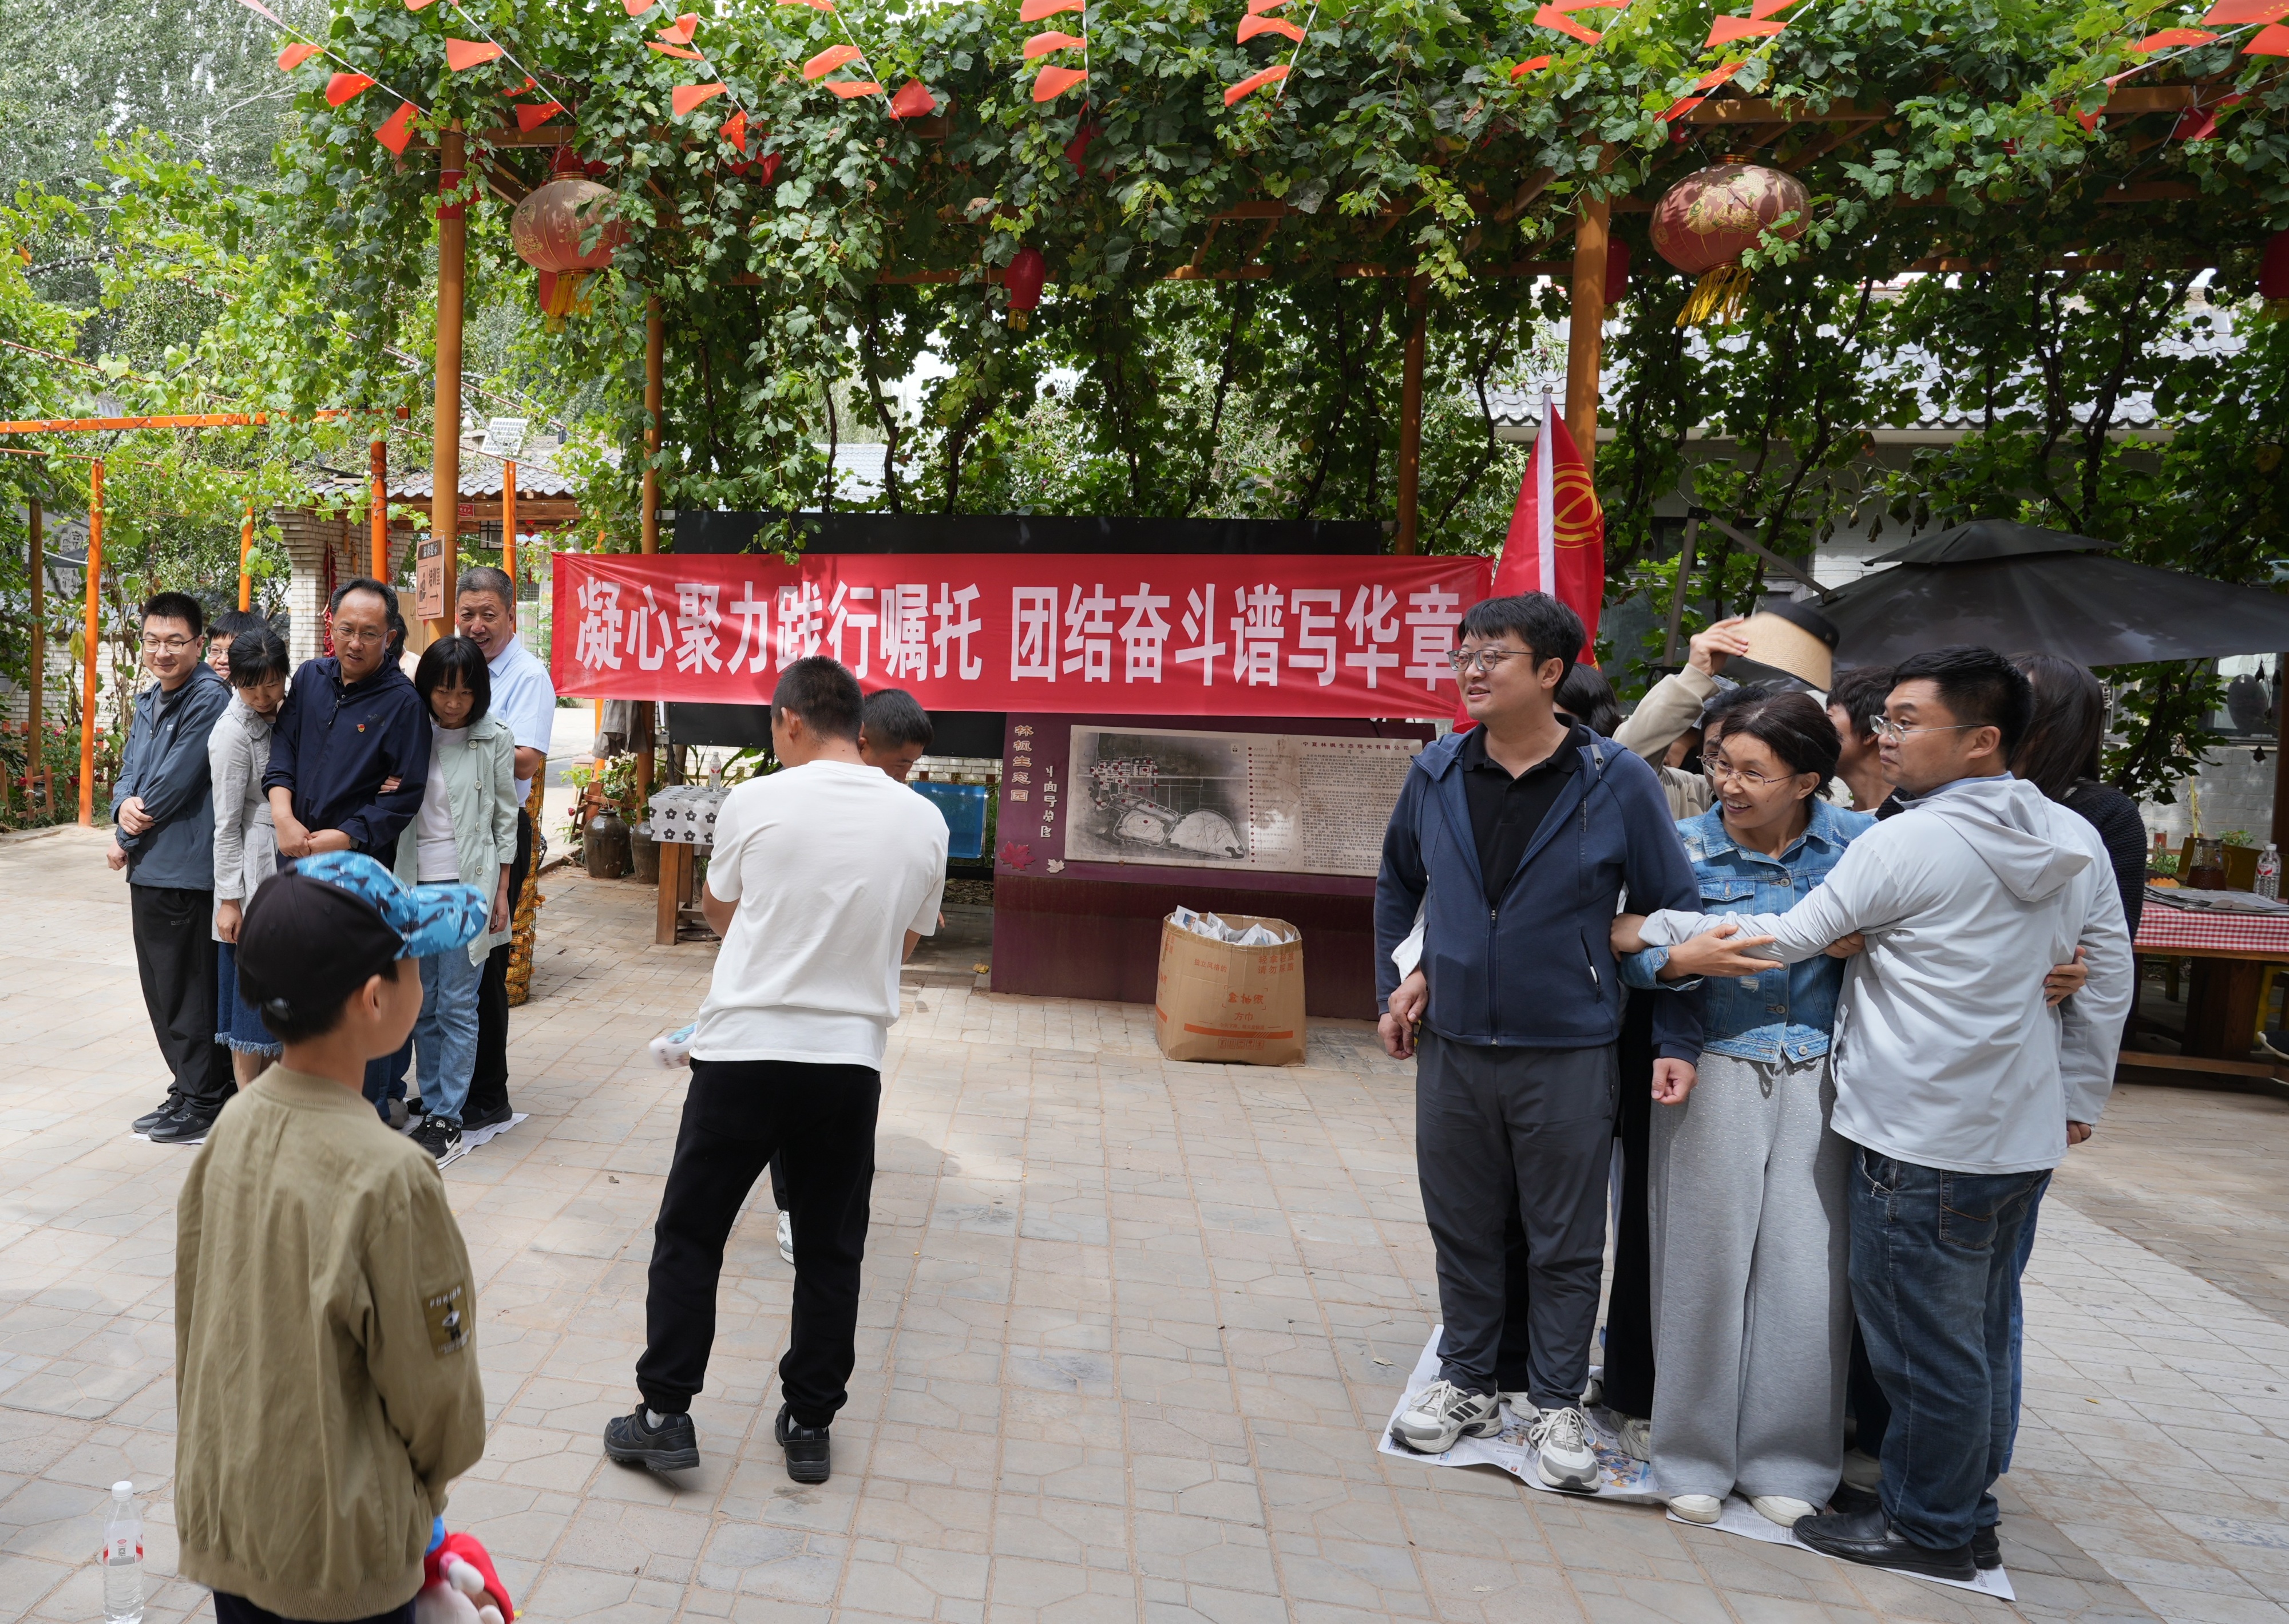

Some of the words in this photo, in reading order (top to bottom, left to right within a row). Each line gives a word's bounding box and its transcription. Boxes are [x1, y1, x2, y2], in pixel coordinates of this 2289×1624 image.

[575, 577, 983, 682] 凝心聚力践行嘱托
[1011, 583, 1463, 691] 团结奋斗谱写华章
[1302, 742, 1409, 751] 宁夏林枫生态观光有限公司
[1011, 725, 1034, 802] 林枫生态园
[1259, 951, 1295, 964] 轻拿轻放
[1194, 958, 1227, 973] 独立风格的
[1257, 962, 1295, 975] 请勿踩踏
[1227, 992, 1264, 1004] 盒抽纸
[1234, 1012, 1254, 1021] 方巾
